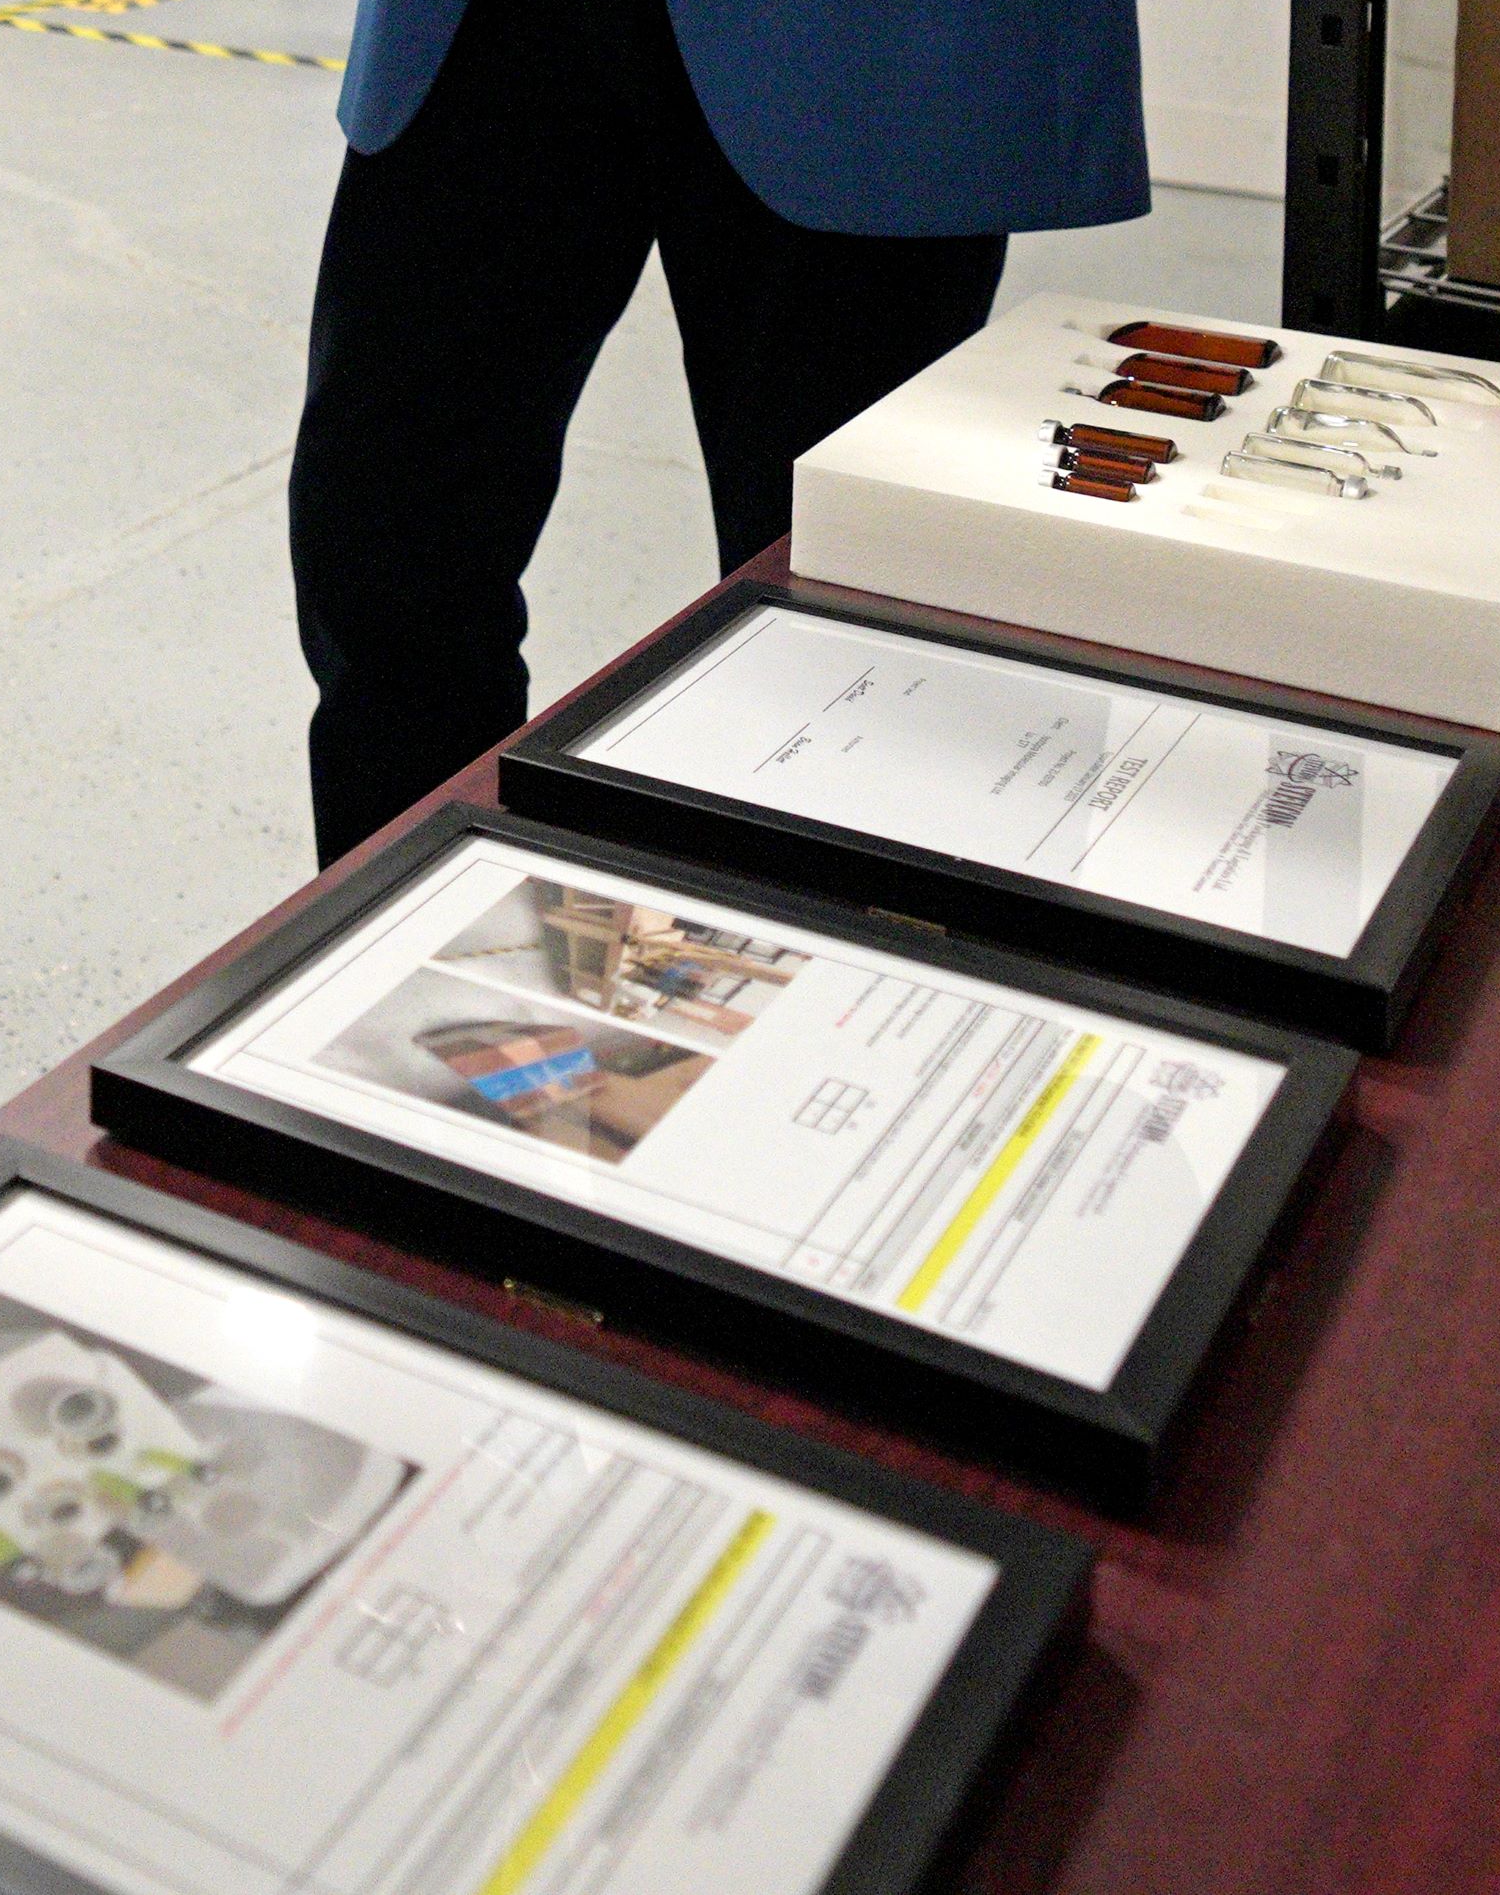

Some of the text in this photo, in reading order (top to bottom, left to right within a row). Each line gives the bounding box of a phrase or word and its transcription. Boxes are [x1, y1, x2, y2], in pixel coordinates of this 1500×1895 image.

[1087, 758, 1147, 810] TEST REPORT
[1257, 781, 1316, 828] STEVCON
